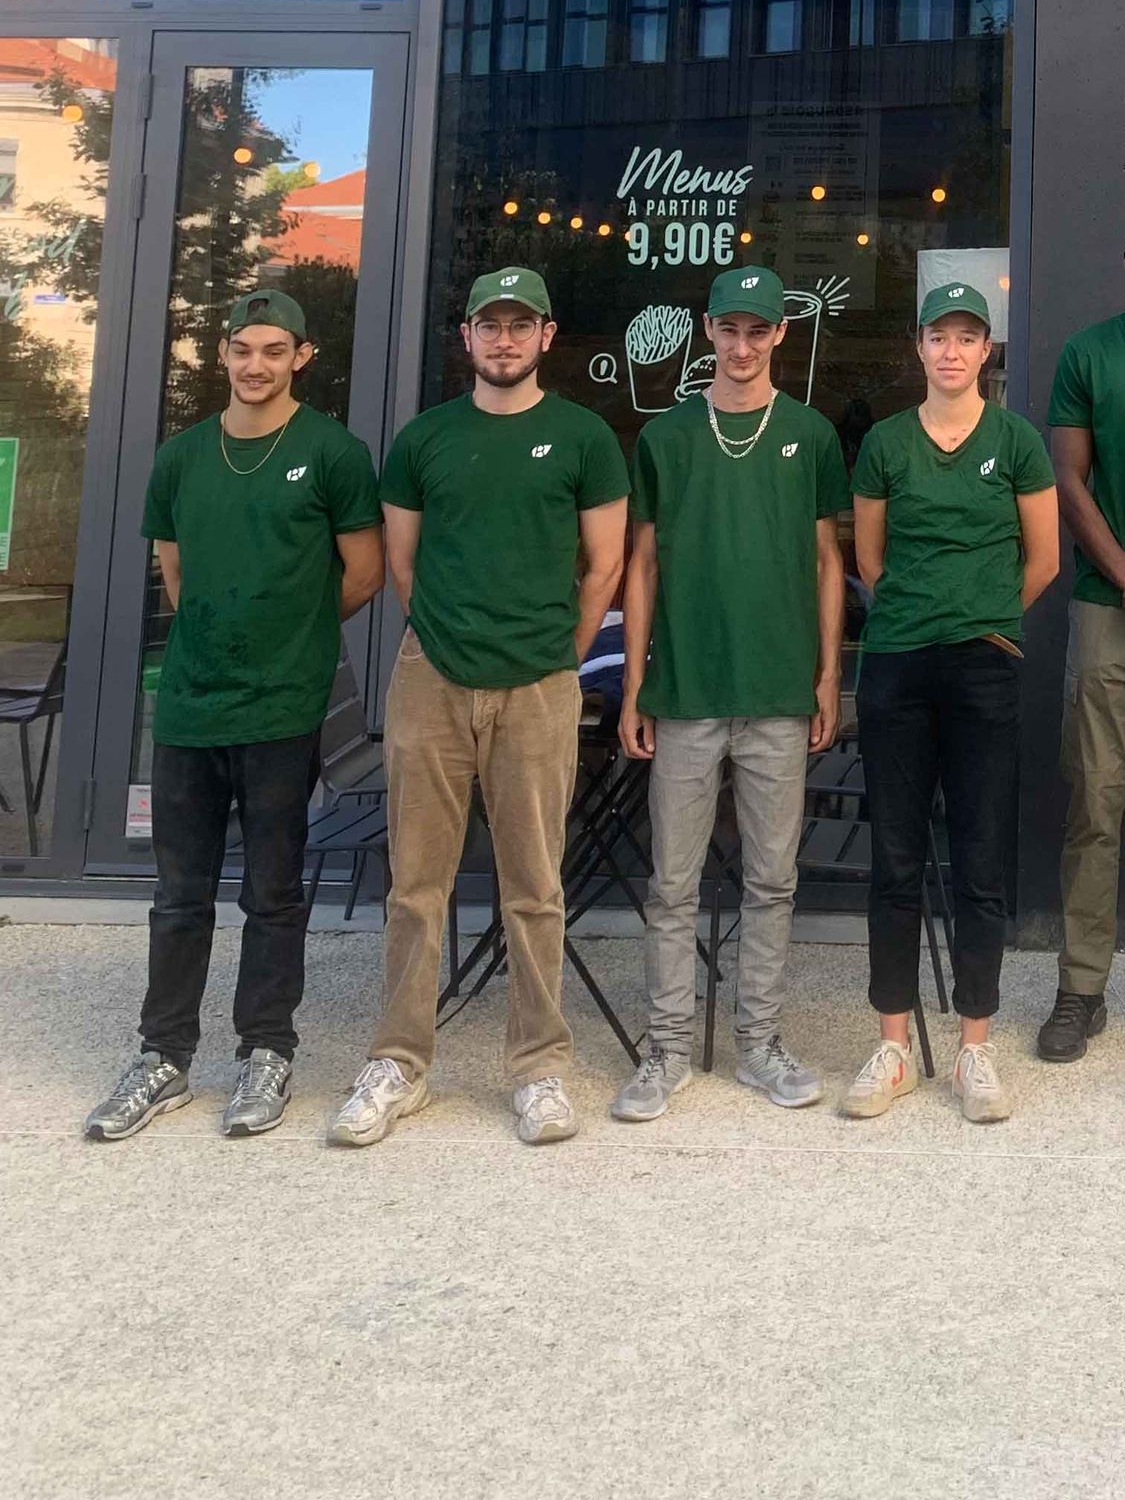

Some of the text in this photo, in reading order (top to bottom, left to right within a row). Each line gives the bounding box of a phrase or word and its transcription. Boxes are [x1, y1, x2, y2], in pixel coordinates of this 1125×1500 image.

[617, 146, 753, 199] Menus
[628, 197, 737, 216] À PARTIR DE
[627, 222, 735, 270] 9,90€
